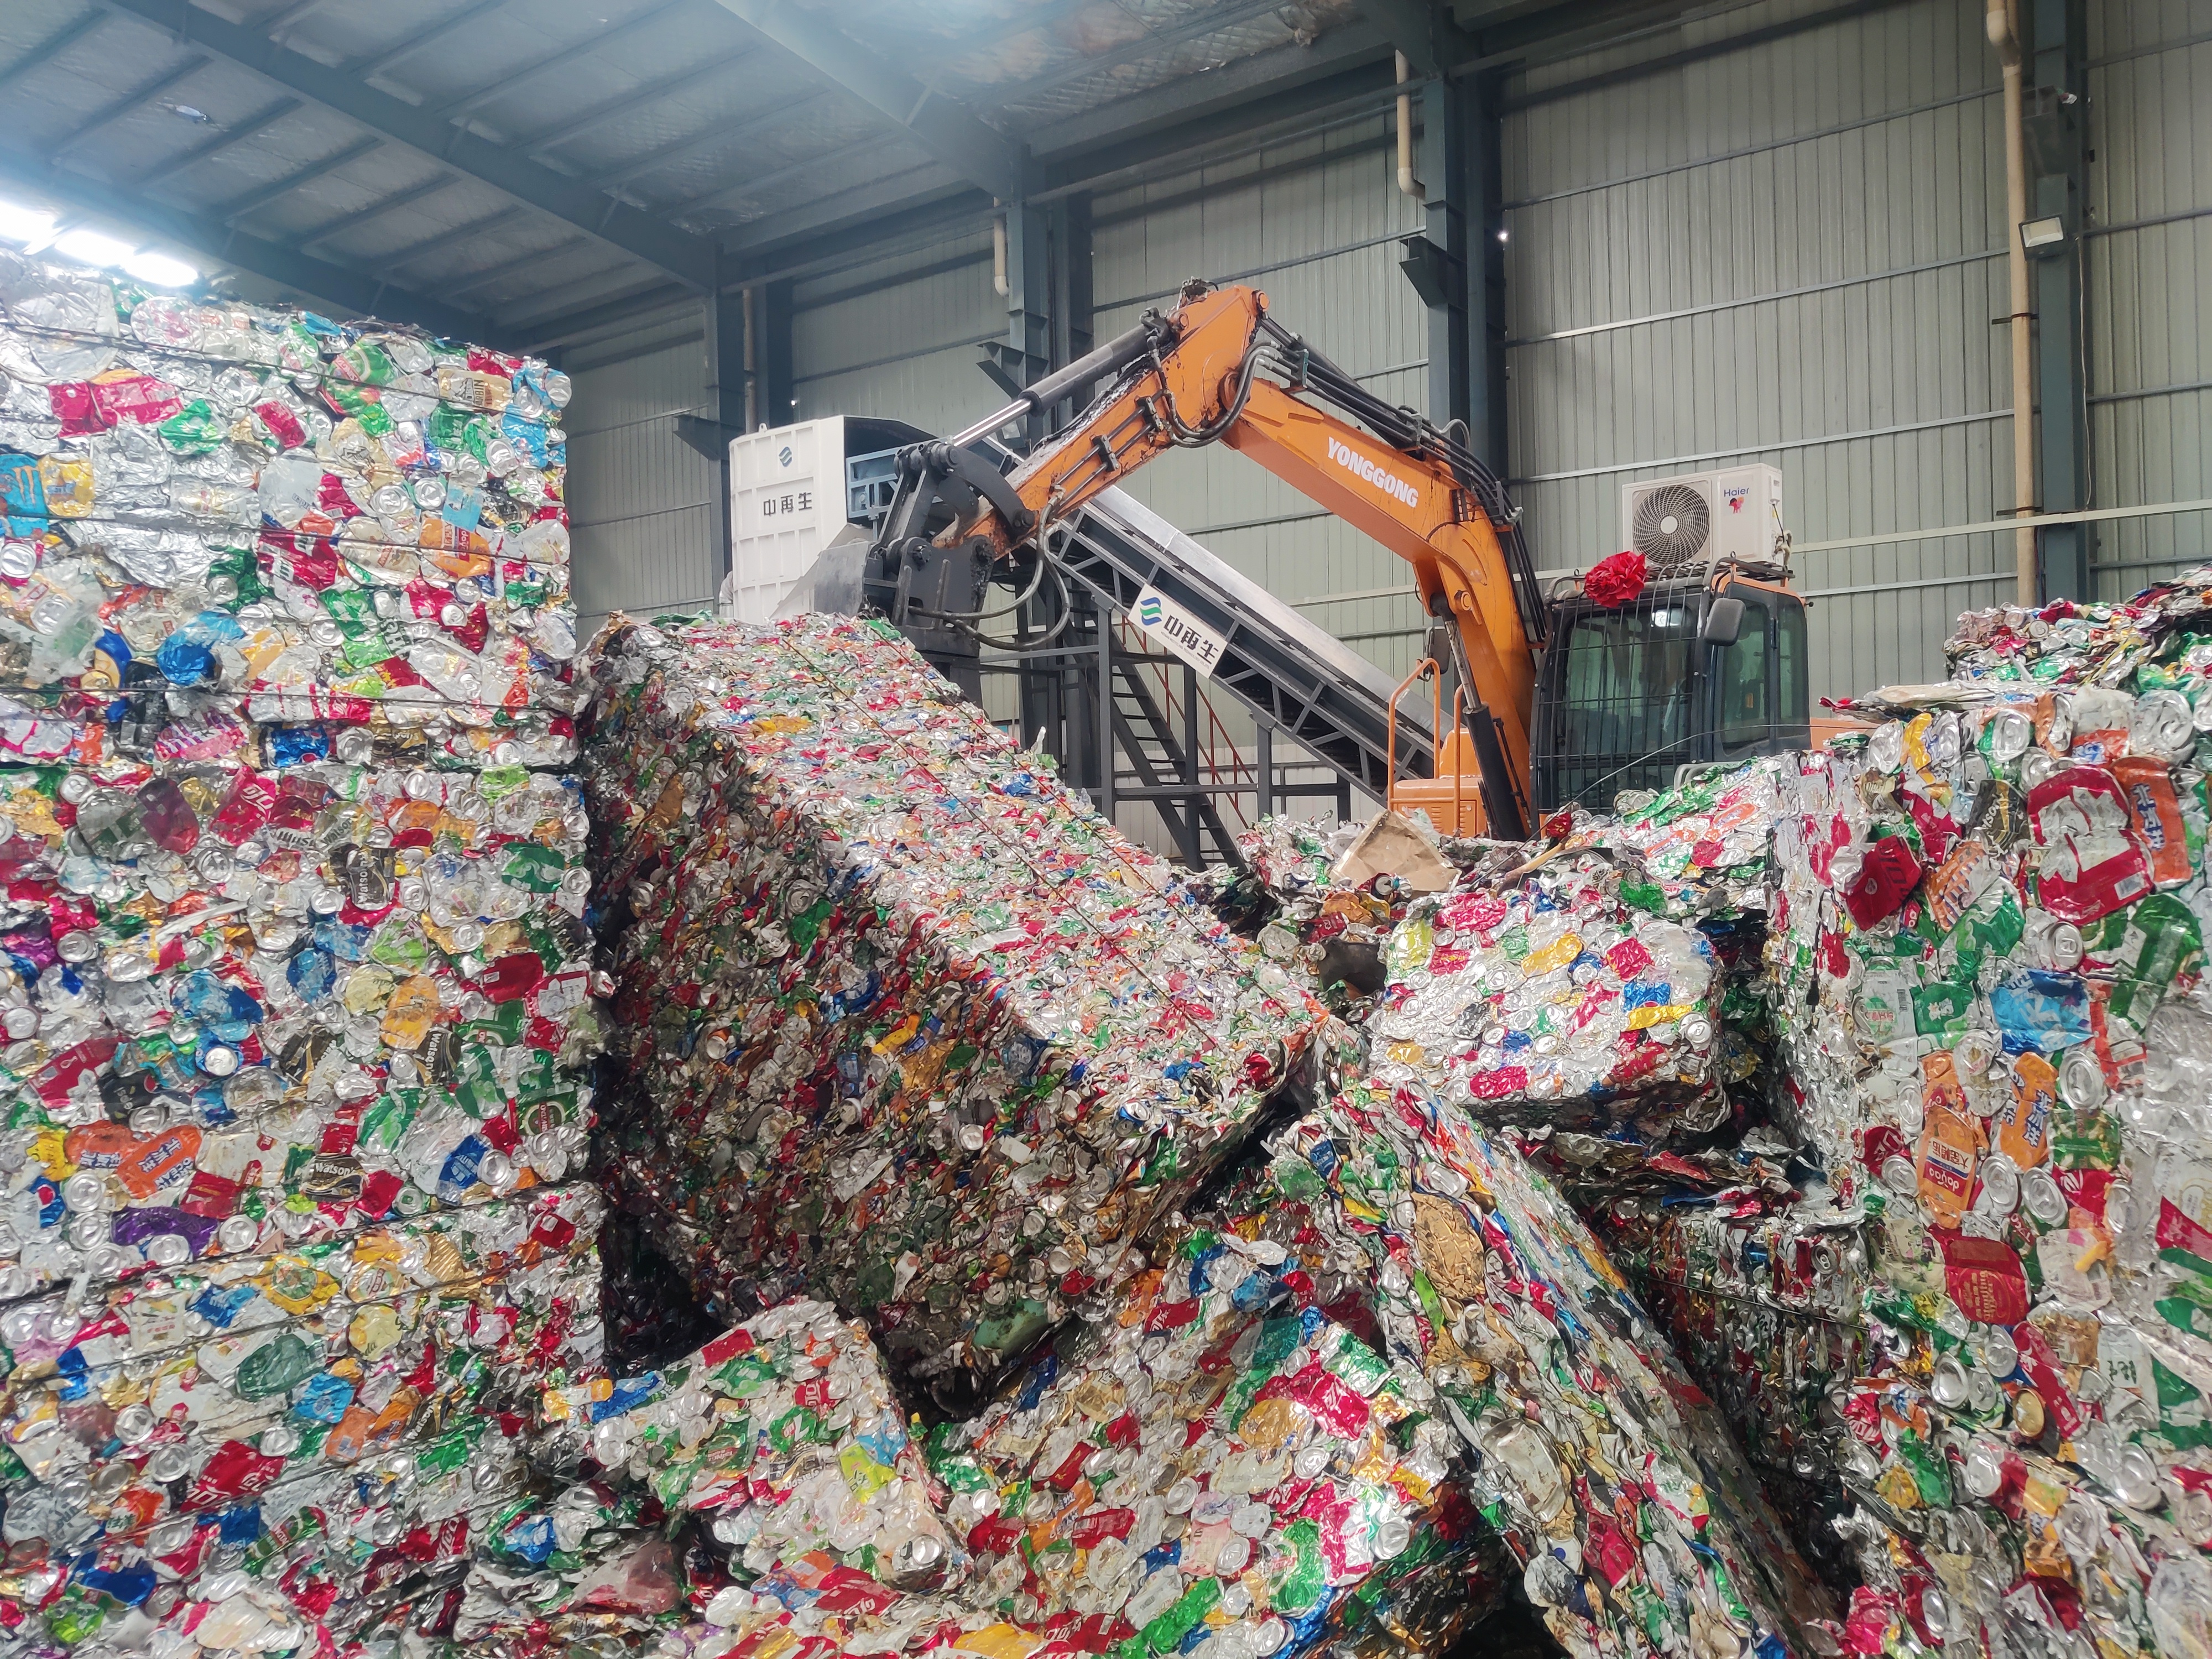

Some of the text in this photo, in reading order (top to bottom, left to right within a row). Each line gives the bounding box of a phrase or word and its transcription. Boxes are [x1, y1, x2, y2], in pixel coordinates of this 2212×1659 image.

[1327, 436, 1419, 508] YONGGONG
[763, 492, 813, 517] 中再生
[1723, 487, 1750, 497] Haier
[1164, 614, 1219, 665] 中再生
[137, 1137, 182, 1174] 北冰洋
[1929, 1167, 1960, 1192] dayao
